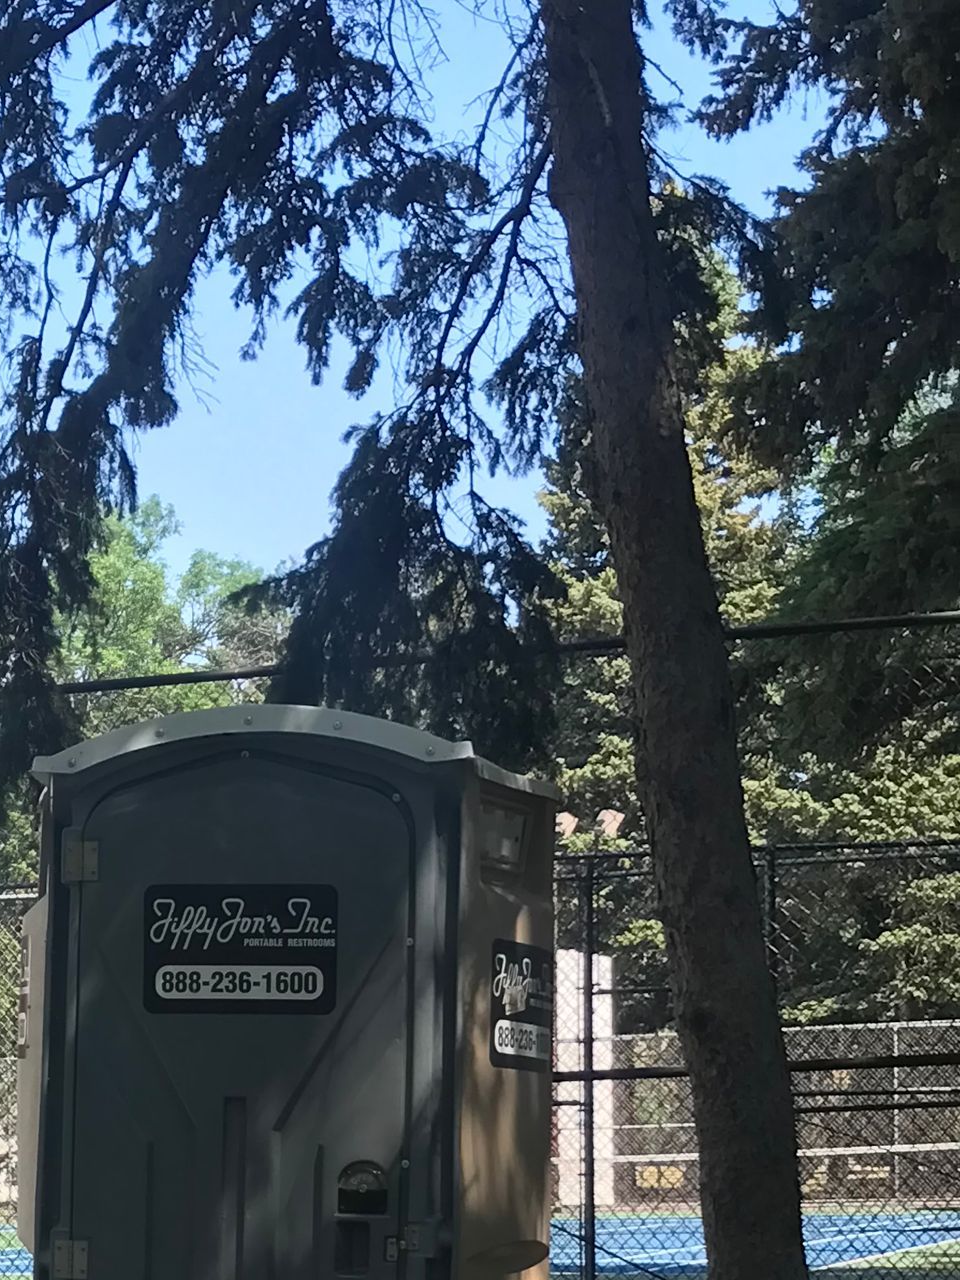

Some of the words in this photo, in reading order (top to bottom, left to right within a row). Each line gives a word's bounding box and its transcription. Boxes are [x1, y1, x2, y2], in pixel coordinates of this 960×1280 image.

[150, 898, 218, 950] Jiffy
[217, 898, 281, 943] Jon's
[282, 898, 336, 934] Inc.
[243, 938, 283, 947] PORTABLE
[287, 938, 336, 947] RESTROOMS
[161, 970, 318, 994] 888-236-1600
